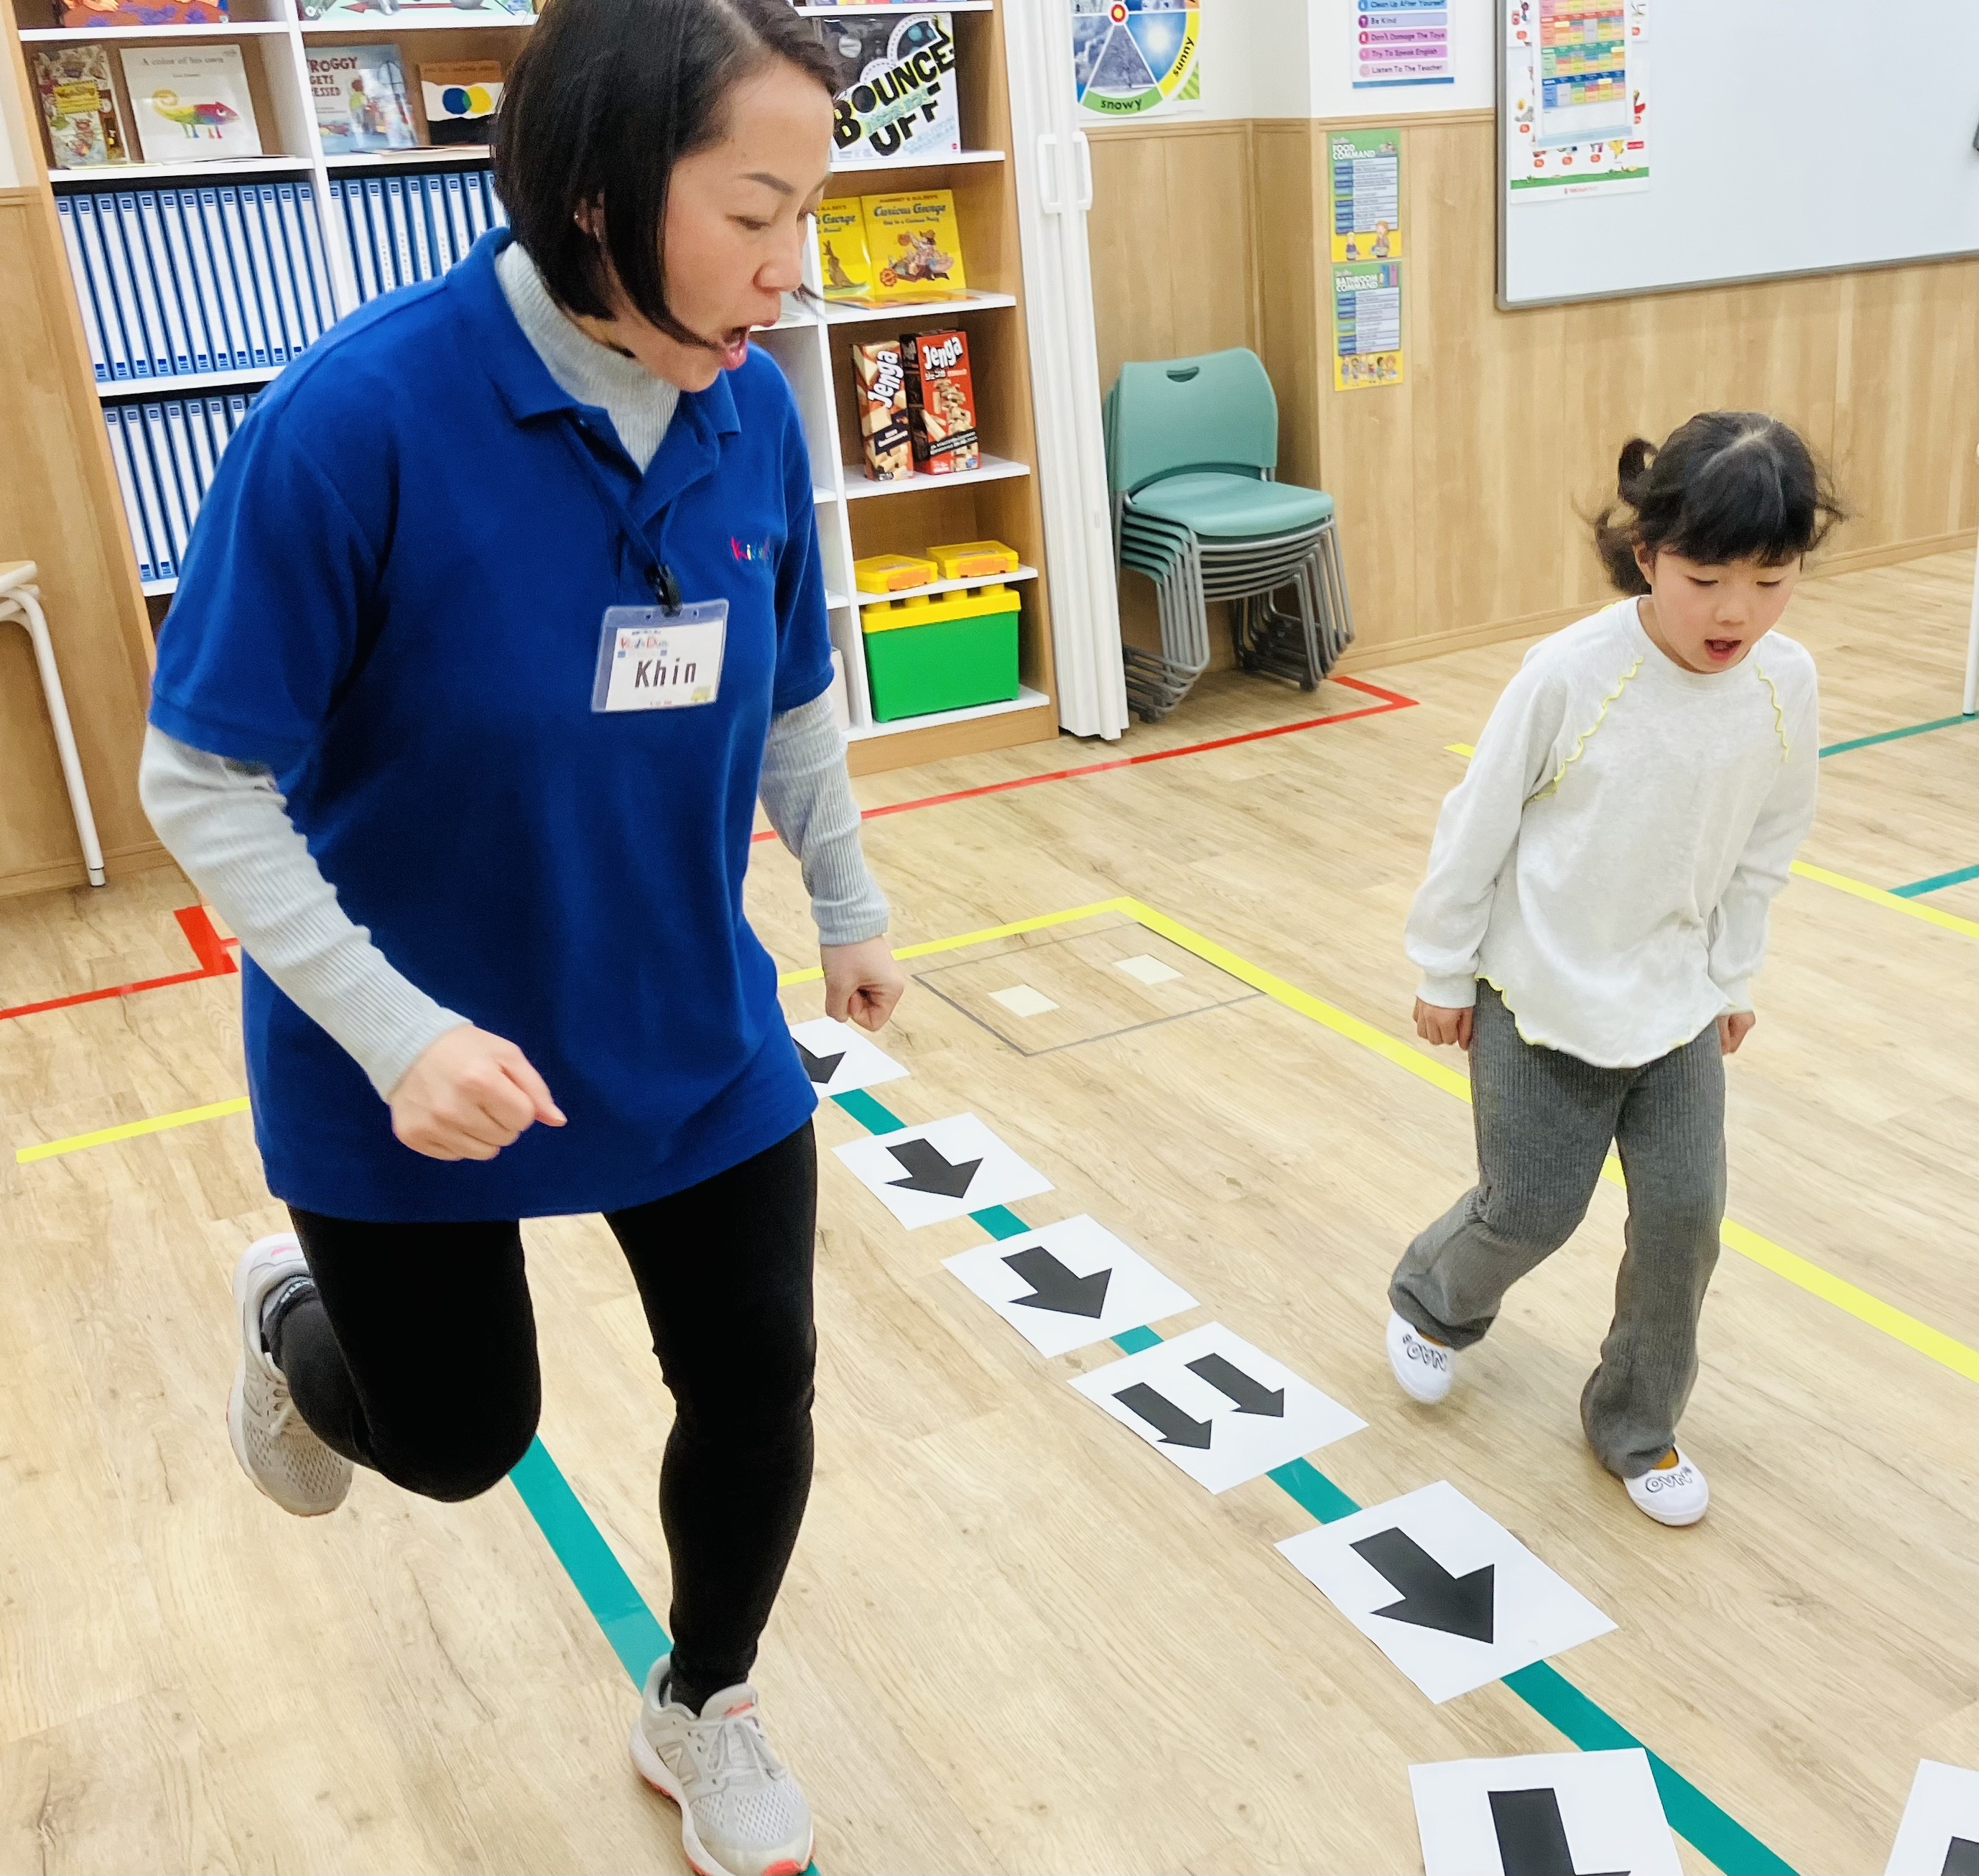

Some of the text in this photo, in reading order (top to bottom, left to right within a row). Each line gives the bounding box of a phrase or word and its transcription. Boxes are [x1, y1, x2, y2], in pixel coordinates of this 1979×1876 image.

[1172, 37, 1195, 77] sunny
[312, 87, 340, 97] ESSED
[833, 20, 955, 149] BOUNCE
[1100, 98, 1143, 111] snowy
[1332, 144, 1355, 153] FOOD
[1333, 149, 1376, 160] COMMAND
[913, 203, 947, 216] George
[923, 336, 963, 370] Jenga
[867, 350, 904, 409] Jenga
[635, 657, 696, 688] Khin
